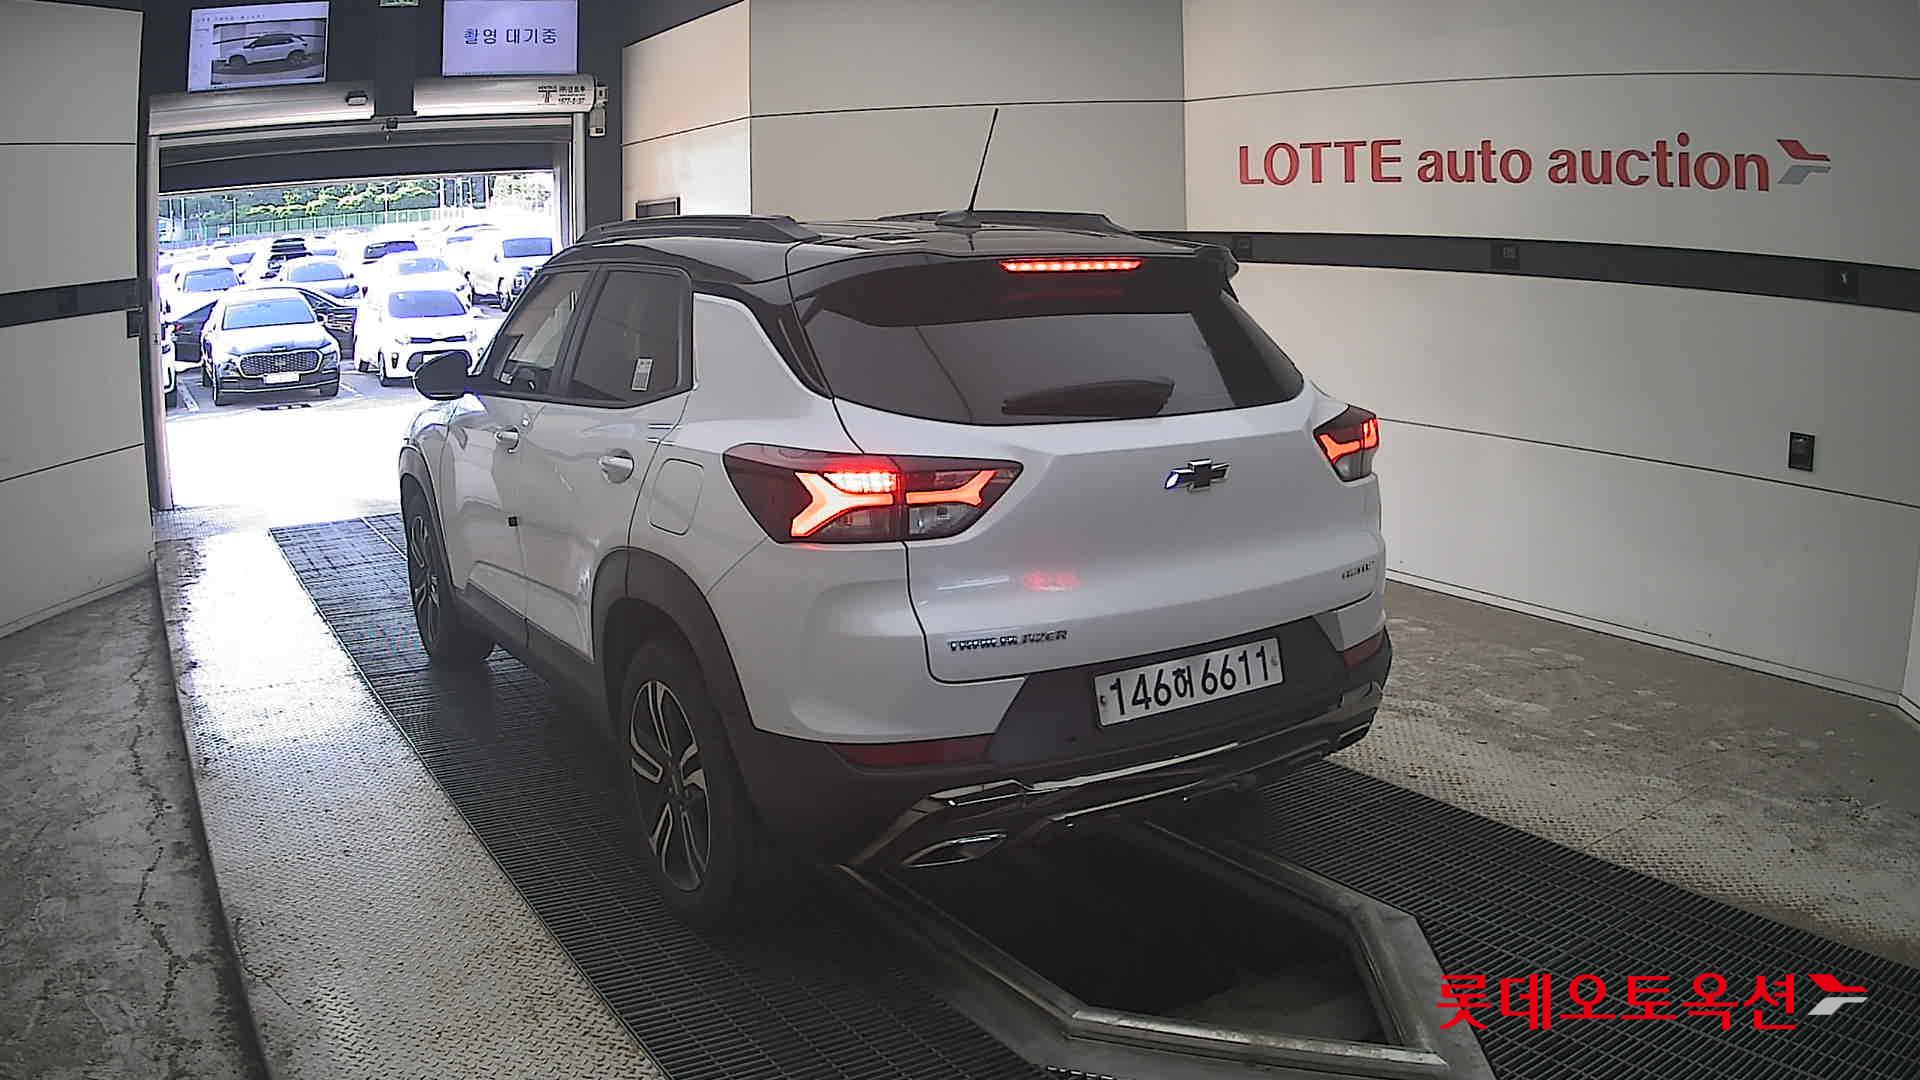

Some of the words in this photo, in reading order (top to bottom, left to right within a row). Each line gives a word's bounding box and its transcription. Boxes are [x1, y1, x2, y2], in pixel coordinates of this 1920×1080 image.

[505, 27, 557, 45] 대기중
[1238, 138, 1402, 186] LOTTE
[1416, 140, 1533, 184] auto
[1547, 132, 1771, 191] auction
